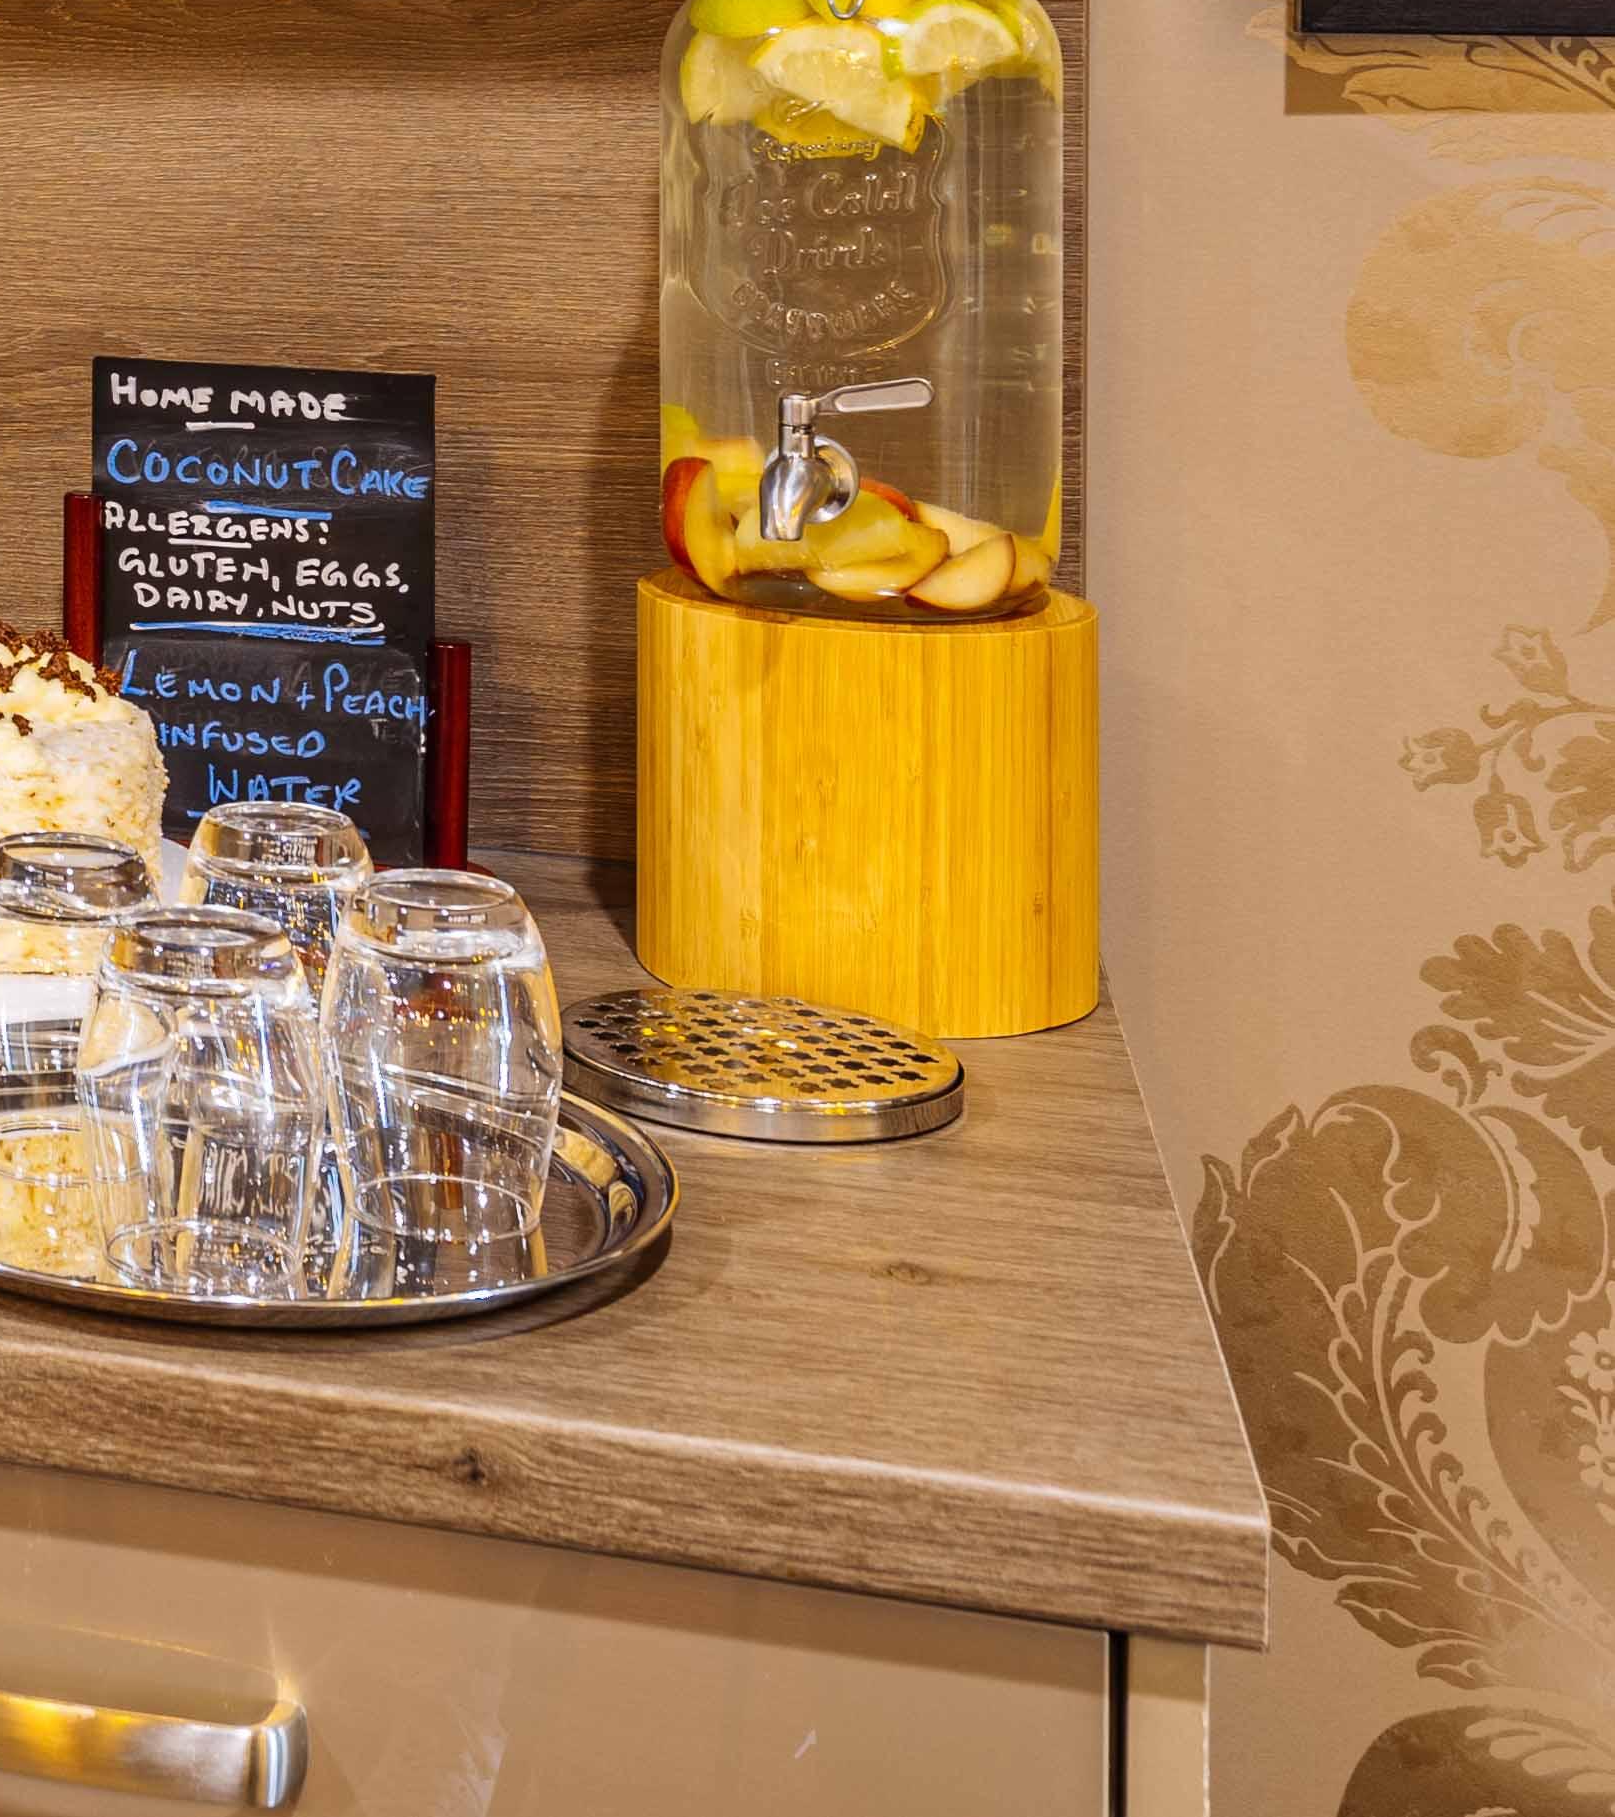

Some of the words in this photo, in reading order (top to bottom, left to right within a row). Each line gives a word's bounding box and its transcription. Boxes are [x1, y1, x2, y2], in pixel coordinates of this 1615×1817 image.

[110, 372, 214, 414] HOME
[229, 389, 347, 422] MADE
[106, 438, 321, 492] COCONUT
[330, 448, 430, 500] CAKE
[118, 548, 281, 591] GLUTEN,
[119, 648, 281, 705] LEMON
[323, 662, 430, 726] PEACH
[159, 720, 327, 757] INFUSED
[207, 763, 362, 812] WATER
